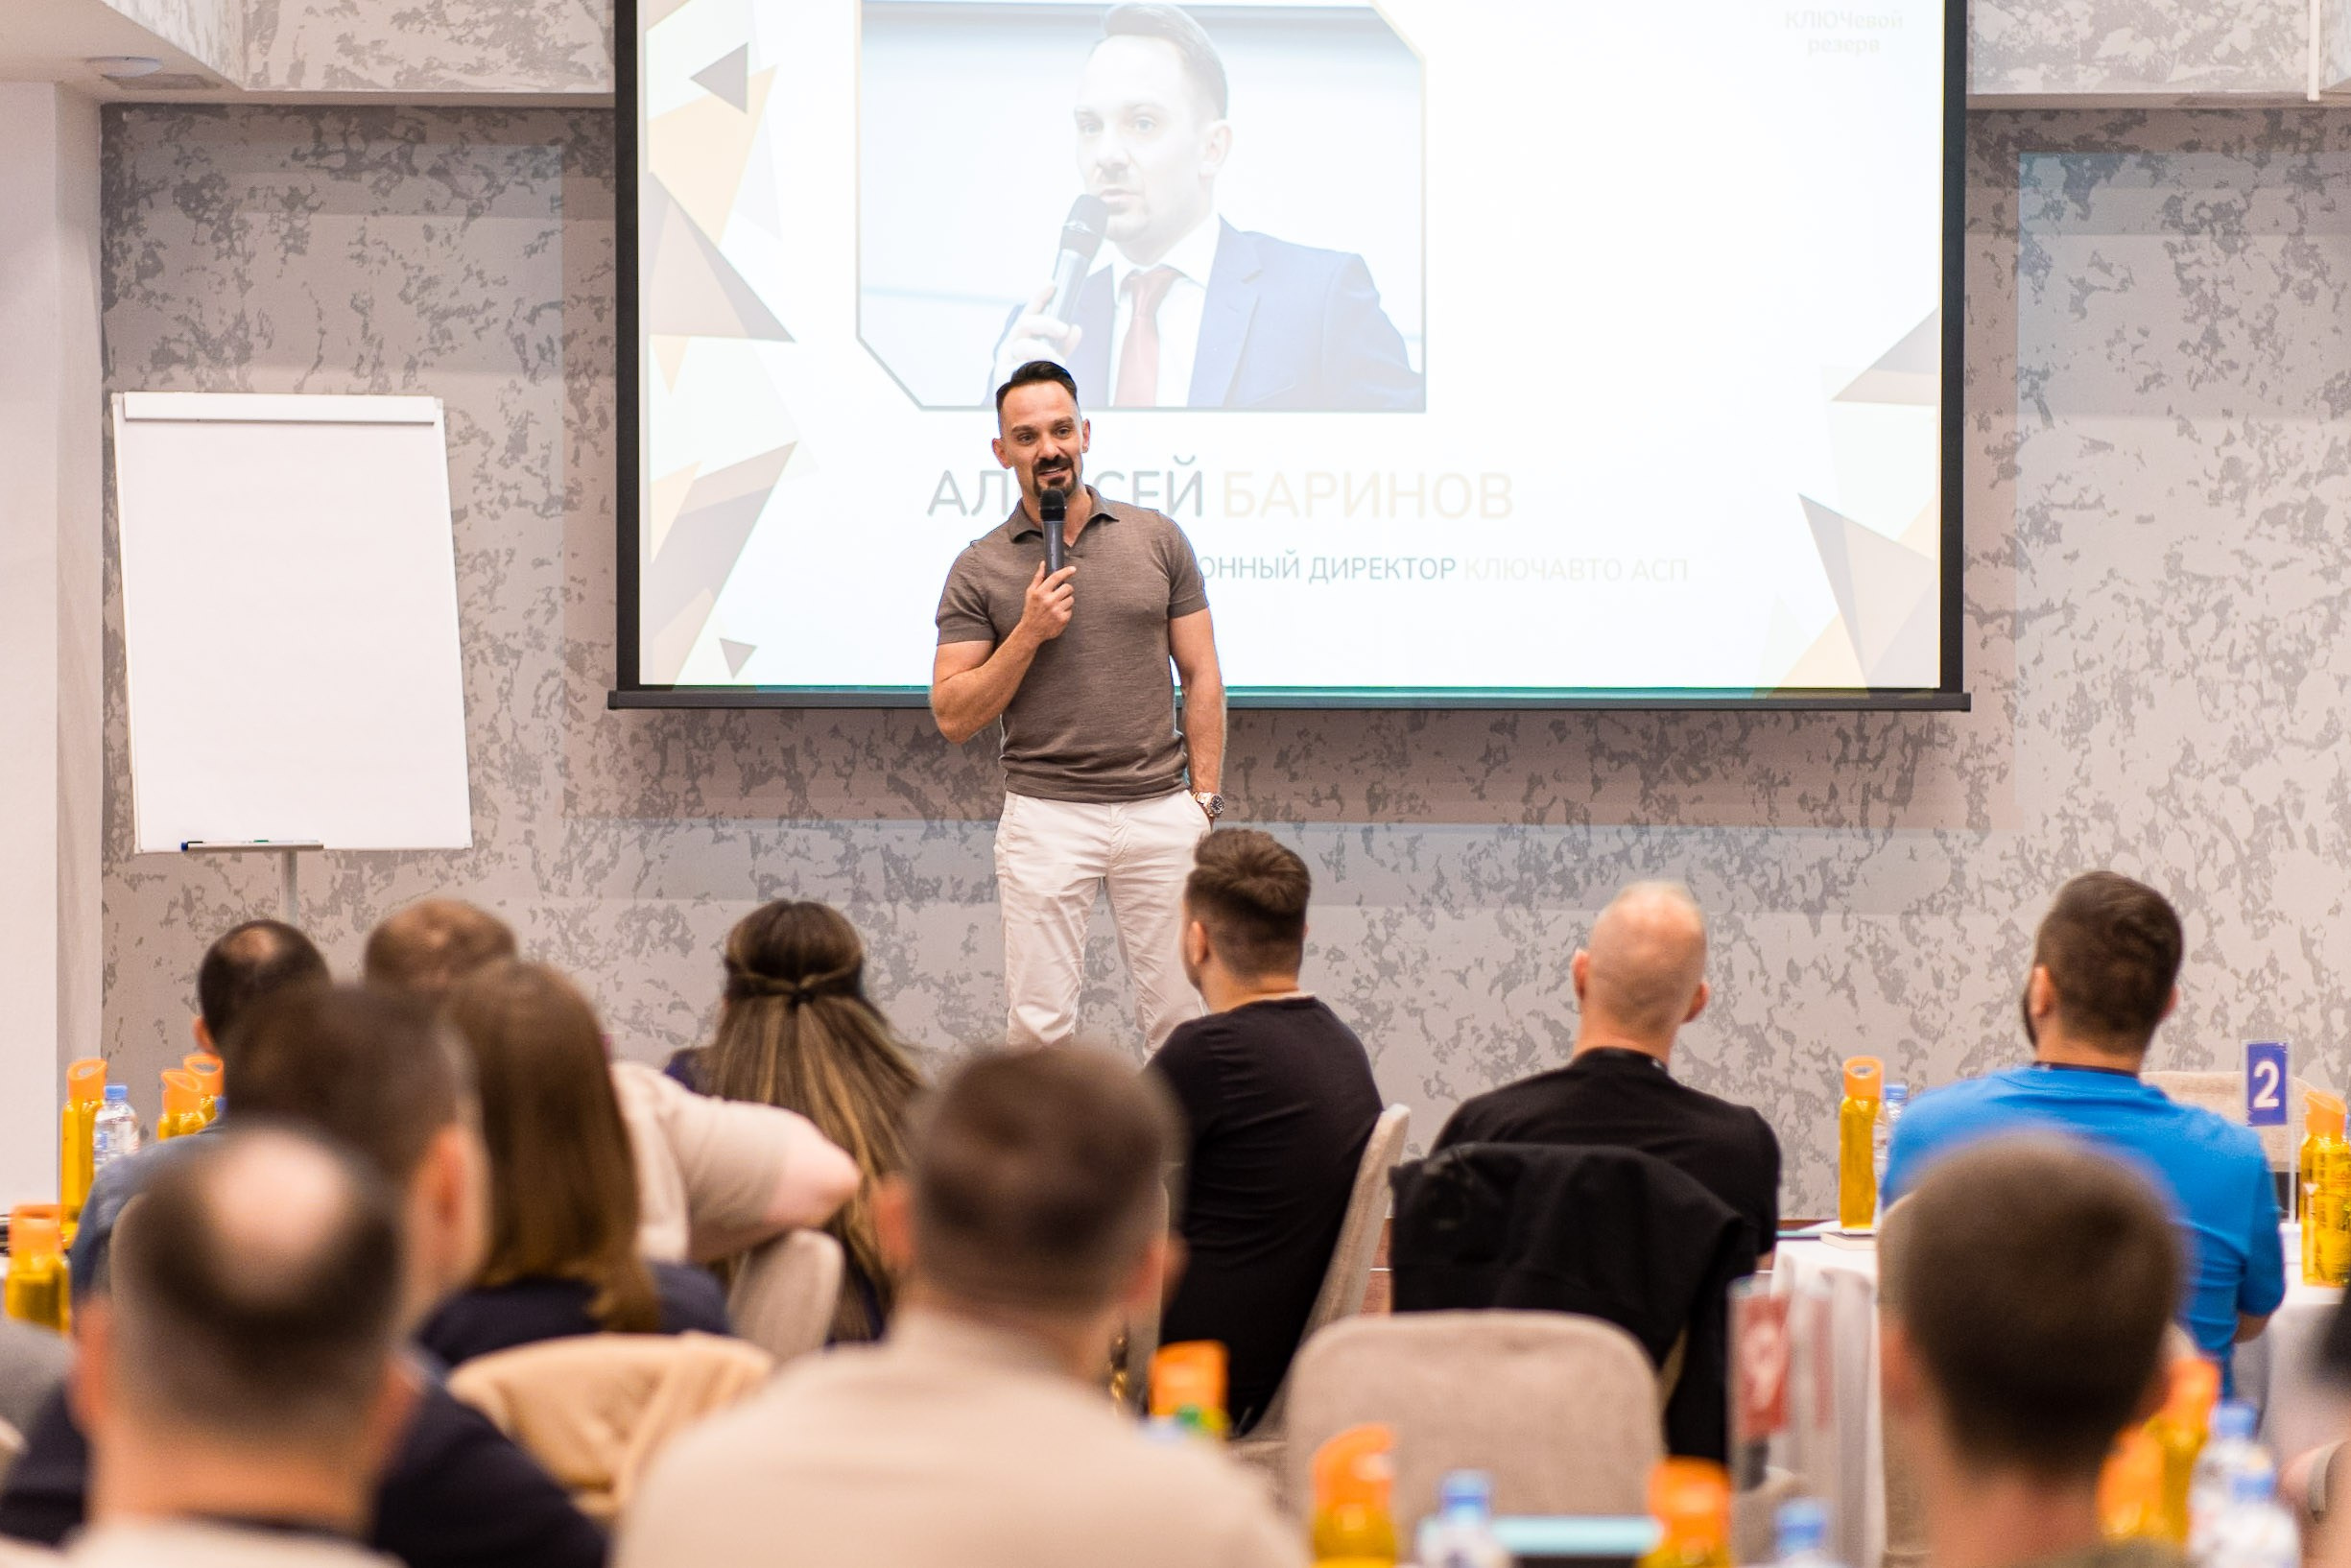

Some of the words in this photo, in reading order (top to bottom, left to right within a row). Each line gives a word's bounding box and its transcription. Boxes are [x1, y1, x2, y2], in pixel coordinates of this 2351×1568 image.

[1807, 37, 1881, 58] резерв
[927, 455, 1202, 517] АЛСЕЙ
[1223, 470, 1515, 520] БАРИНОВ
[1197, 549, 1299, 580] ОННЫЙ
[1308, 556, 1457, 584] ДИРЕКТОР
[1464, 558, 1623, 582] КЛЮЧАВТО
[1630, 558, 1689, 582] АСП
[2252, 1060, 2280, 1108] 2
